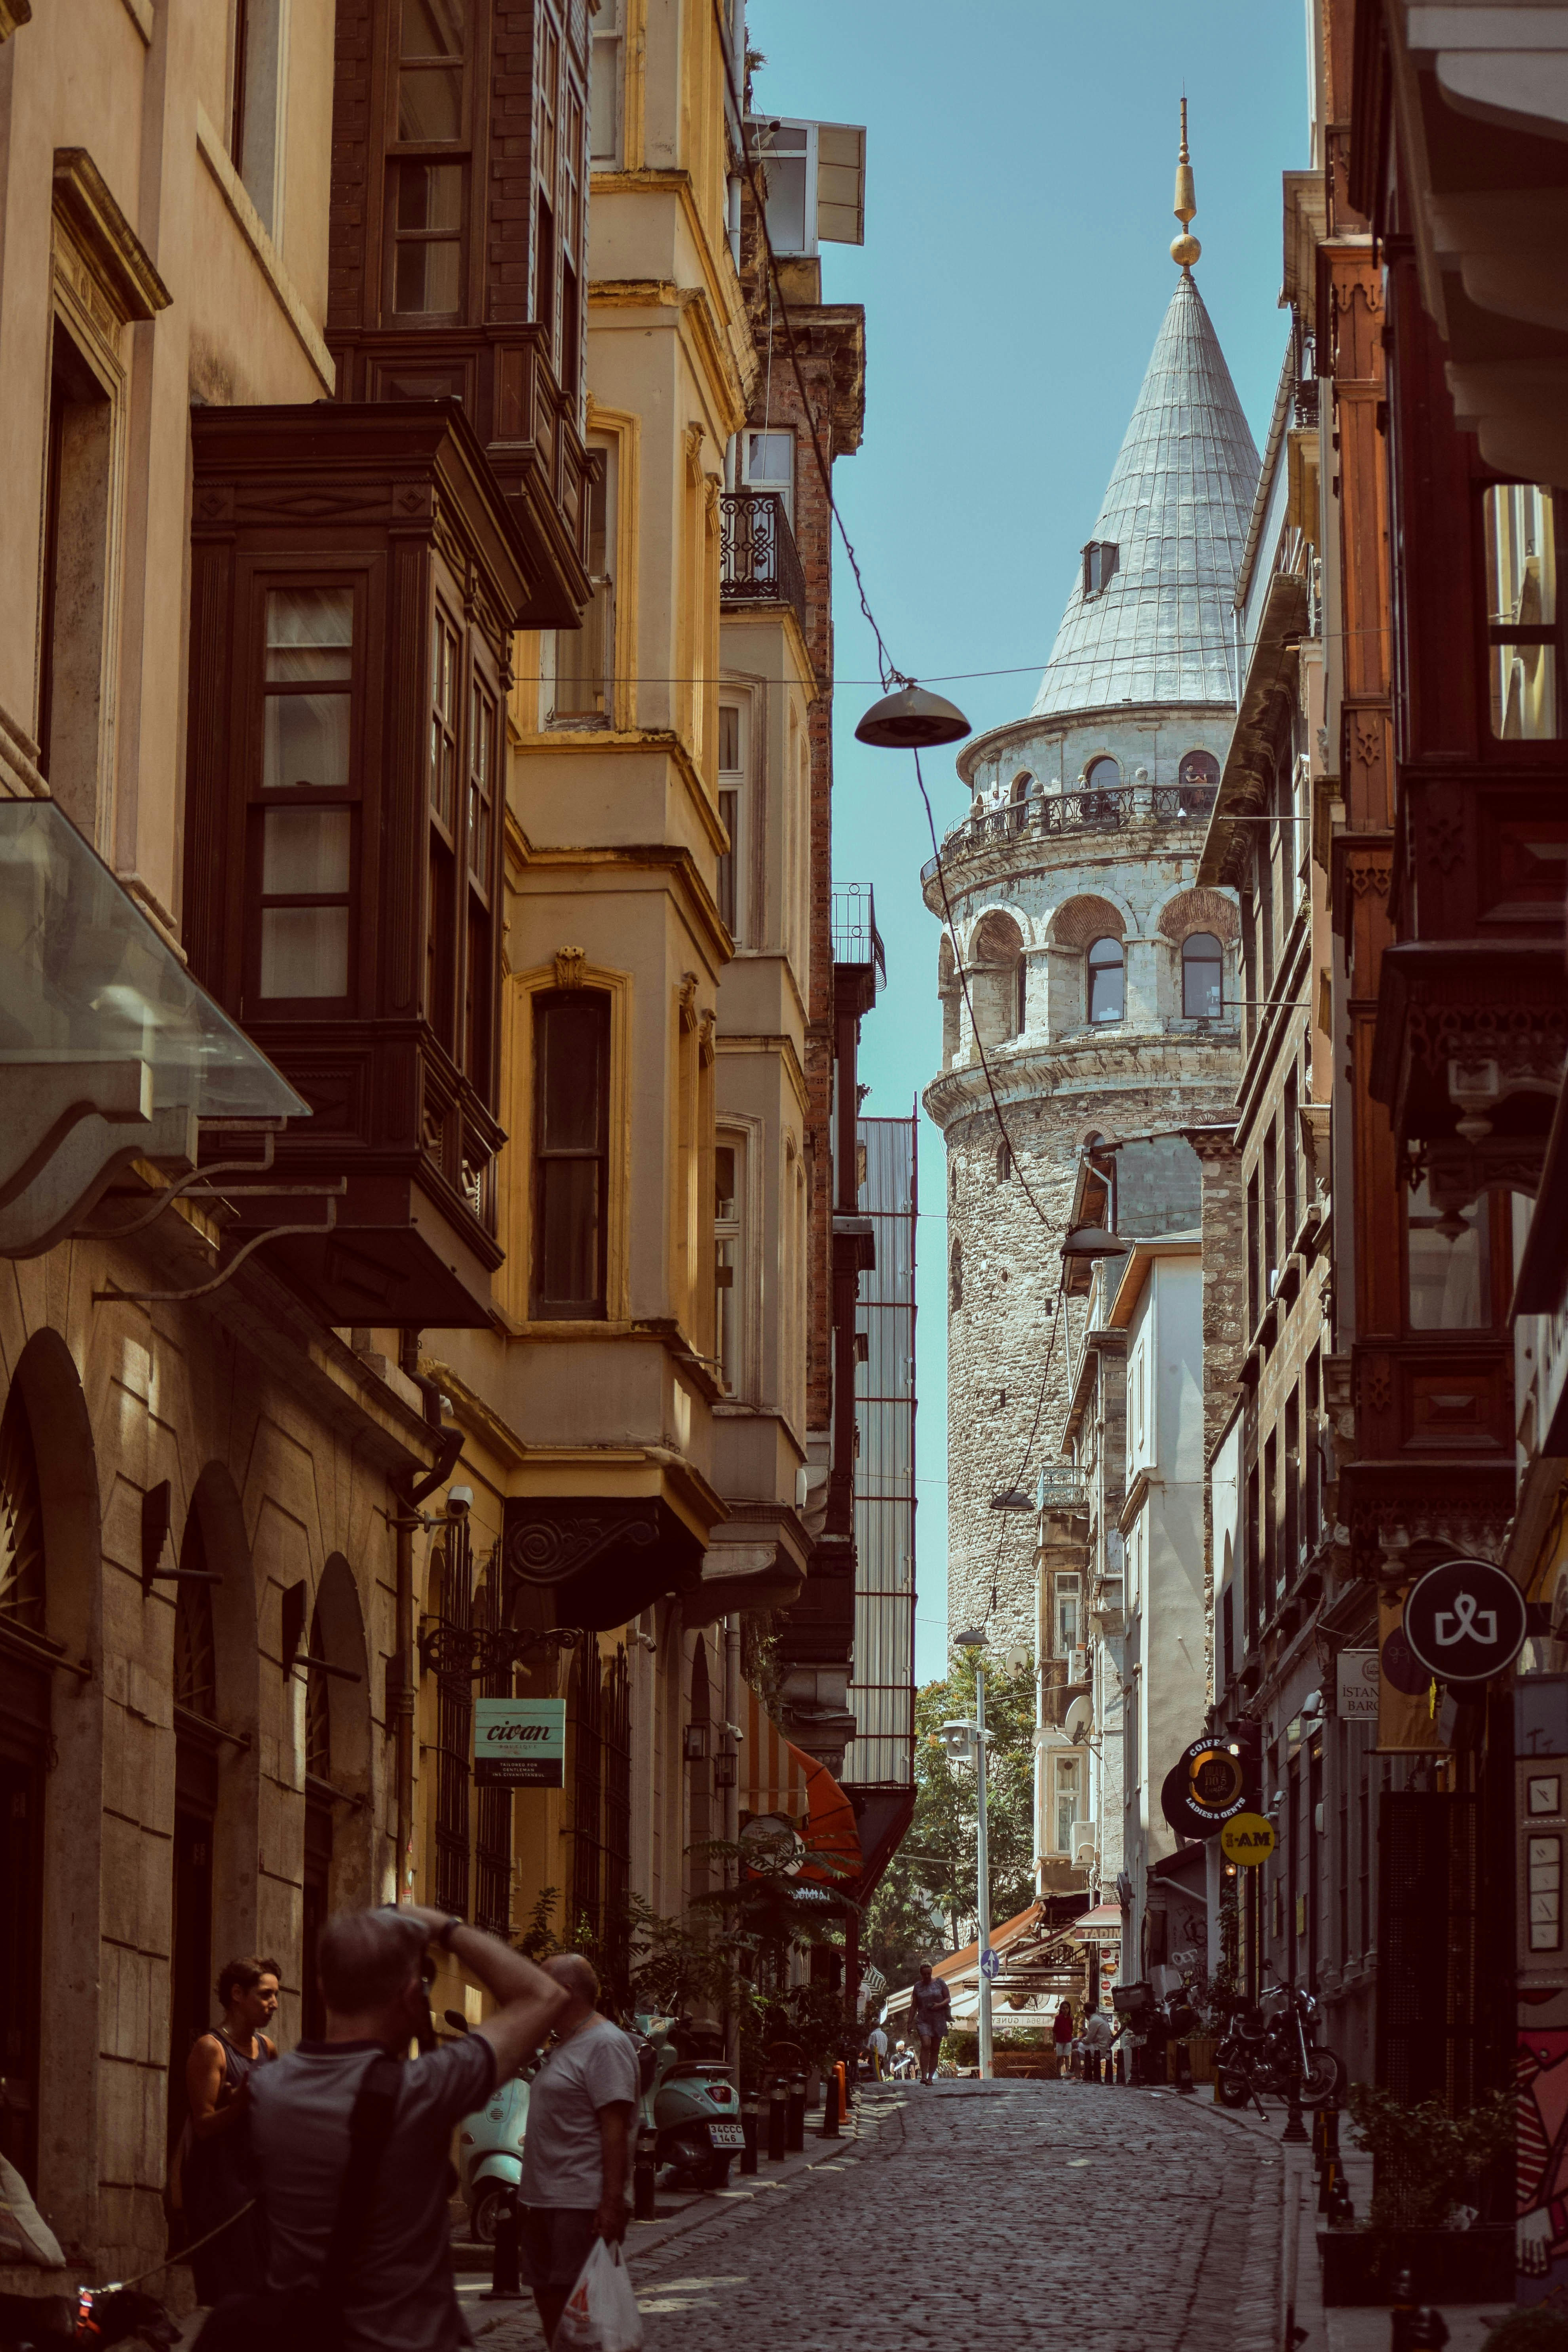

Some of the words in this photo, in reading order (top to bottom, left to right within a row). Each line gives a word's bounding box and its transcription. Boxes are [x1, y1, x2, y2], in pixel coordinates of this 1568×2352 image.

[487, 1721, 552, 1741] civan
[1185, 1797, 1213, 1820] LADIES
[1220, 1796, 1247, 1819] GENTS
